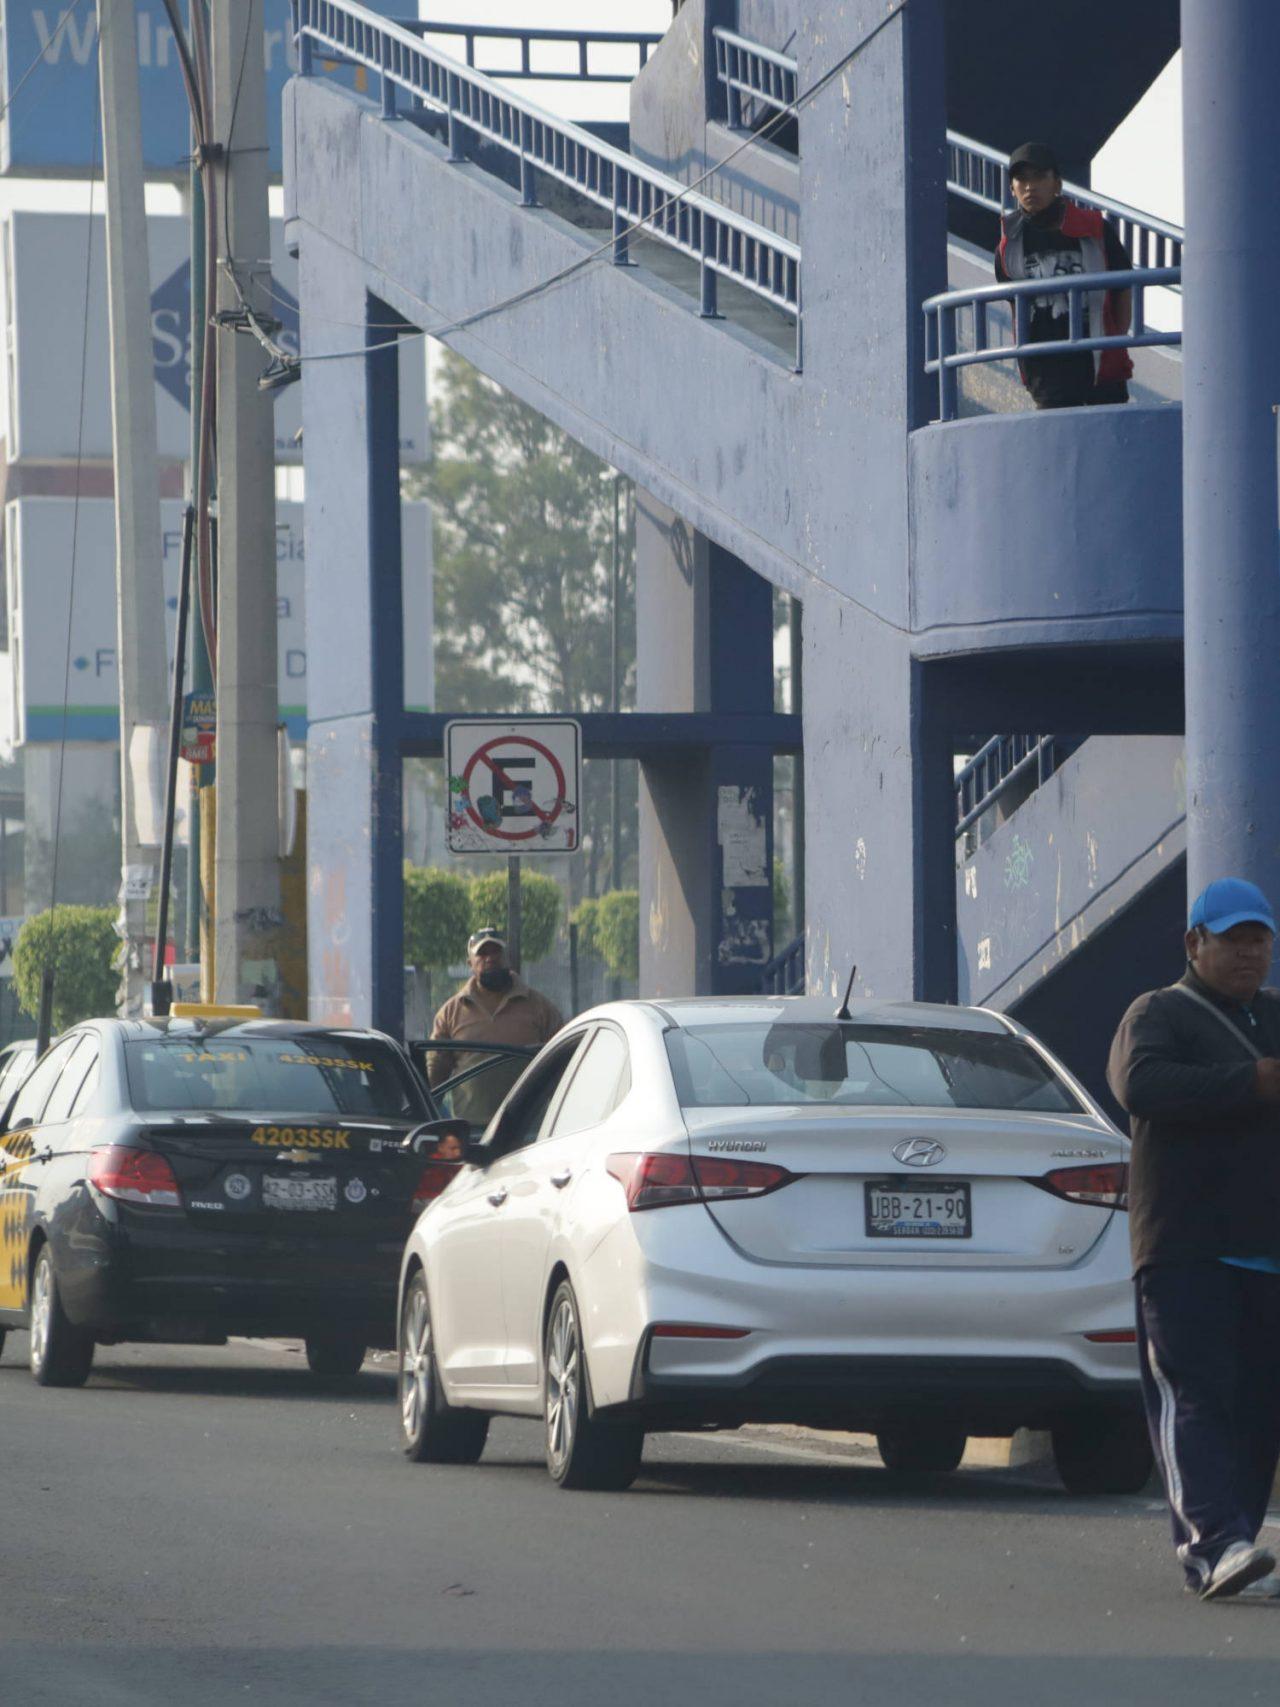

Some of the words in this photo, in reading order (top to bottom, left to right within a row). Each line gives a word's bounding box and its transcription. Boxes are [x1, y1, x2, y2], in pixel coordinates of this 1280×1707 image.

[181, 1052, 246, 1064] TAXI
[251, 1126, 350, 1149] 4203SSK
[708, 1140, 767, 1152] HYUNDAI
[871, 1197, 965, 1220] UBB-21-90
